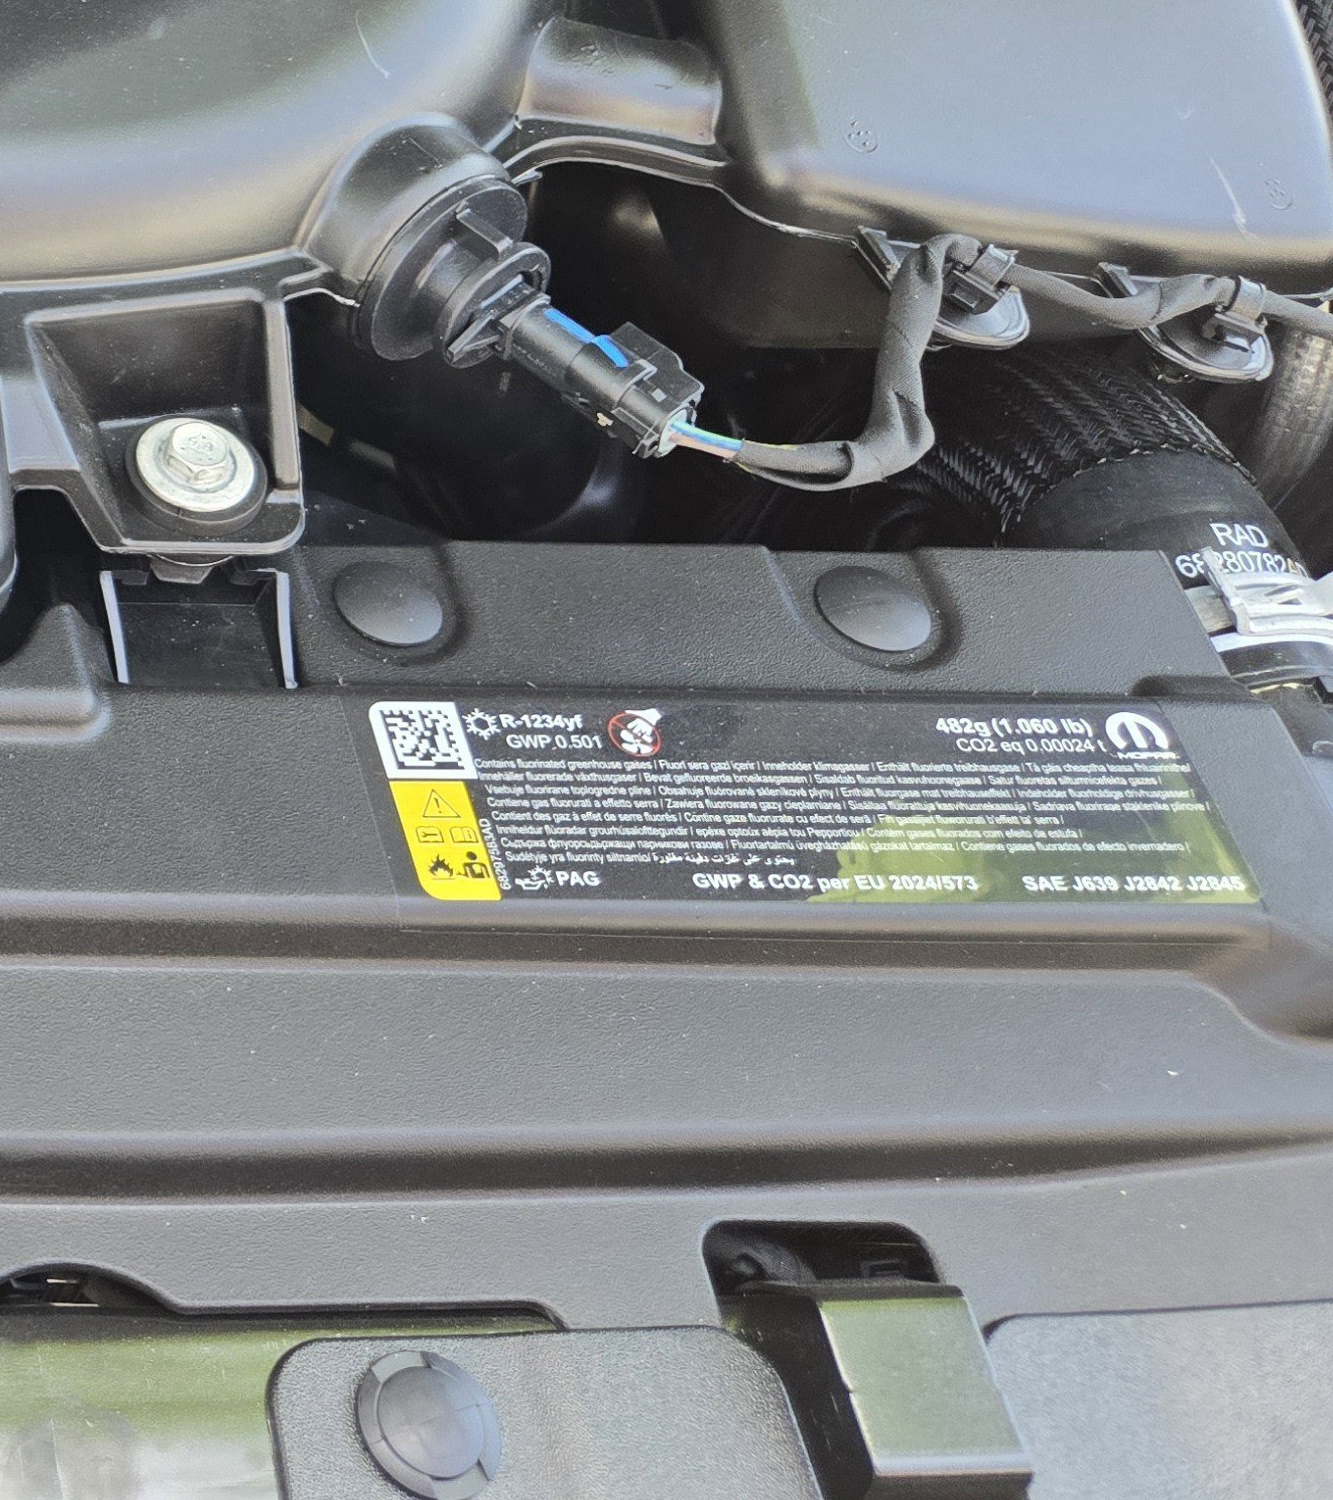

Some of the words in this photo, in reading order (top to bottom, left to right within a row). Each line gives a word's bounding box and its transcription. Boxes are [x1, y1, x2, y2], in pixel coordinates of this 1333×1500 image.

[1210, 523, 1269, 548] RAD
[499, 713, 583, 731] R-1234yf
[935, 717, 991, 736] 482g
[991, 718, 1057, 737] (1.060
[1060, 718, 1093, 737] lb)
[506, 735, 552, 748] GWP
[554, 735, 603, 749] 0.501
[956, 738, 997, 752] CO2
[1000, 741, 1025, 755] eq
[1025, 738, 1095, 752] 0.00024
[1097, 739, 1107, 752] t
[474, 759, 516, 769] Contains
[516, 759, 566, 769] fluorinated
[567, 760, 622, 771] greenhouse
[623, 762, 652, 771] gases
[487, 797, 530, 807] Contiene
[531, 799, 550, 810] gas
[491, 811, 532, 821] Contient
[533, 812, 551, 821] des
[552, 813, 570, 823] gaz
[604, 812, 616, 822] de
[556, 870, 600, 887] PAG
[692, 873, 744, 889] GWP
[747, 873, 765, 889] &
[768, 873, 814, 889] CO2
[817, 877, 850, 893] per
[854, 874, 885, 890] EU
[889, 874, 979, 891] 2024/573
[1021, 875, 1069, 892] SAE
[1072, 875, 1119, 892] J639
[1123, 875, 1182, 892] J2842
[1186, 875, 1246, 892] J2845
